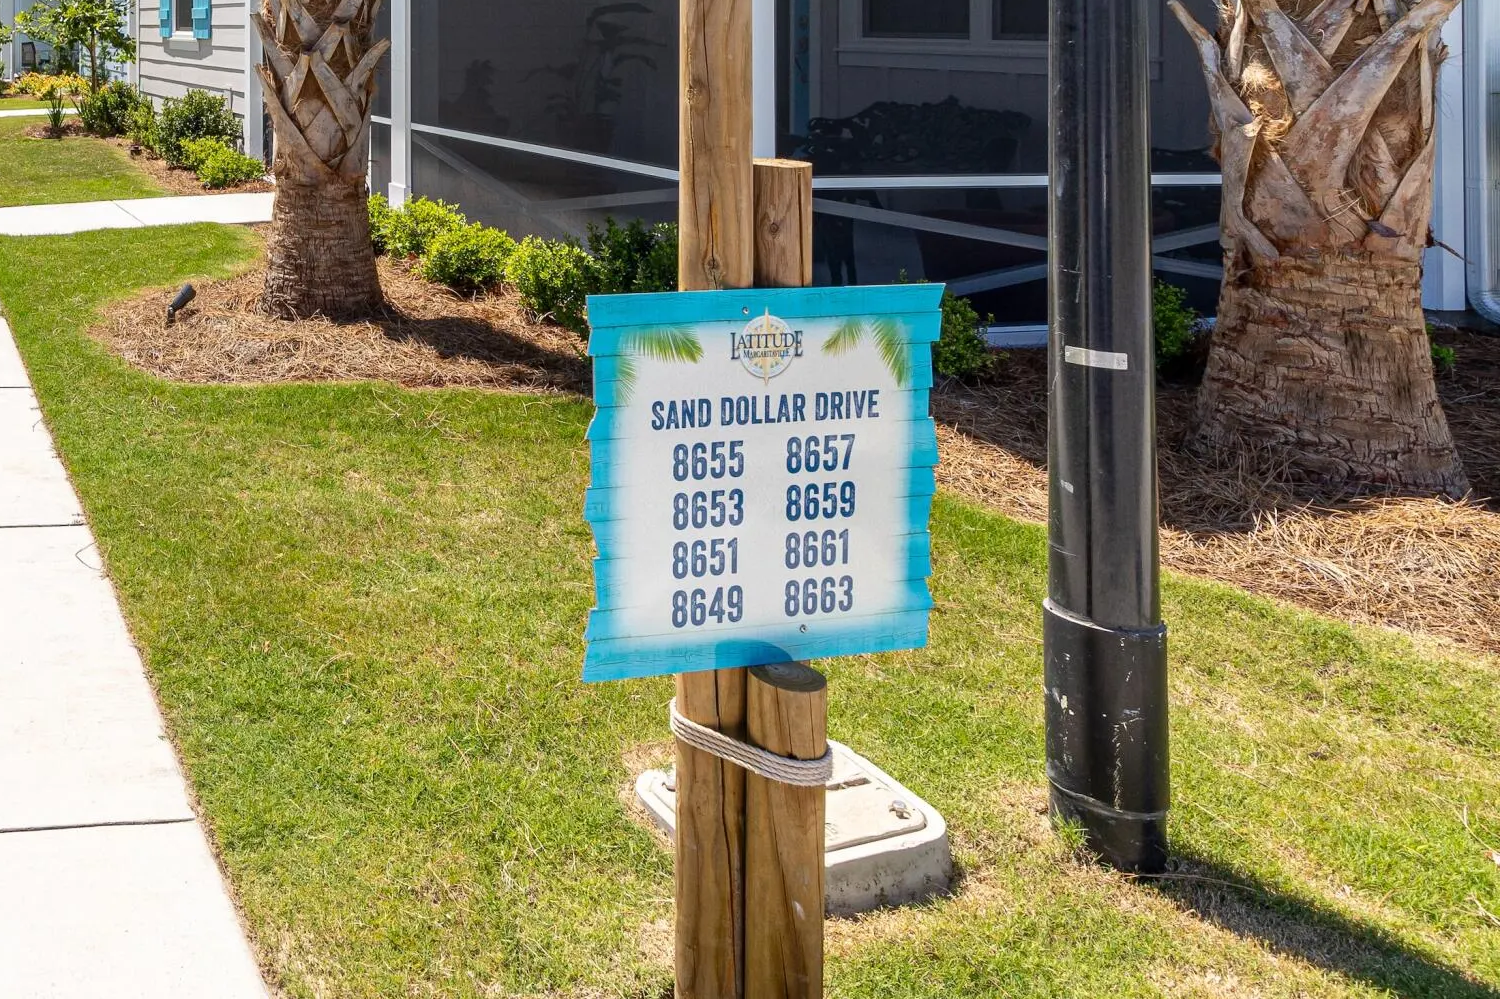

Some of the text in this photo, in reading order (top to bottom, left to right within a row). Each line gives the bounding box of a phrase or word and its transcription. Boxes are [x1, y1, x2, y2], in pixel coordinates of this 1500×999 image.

[730, 330, 804, 360] LATITUDE
[651, 389, 880, 431] SAND DOLLAR DRIVE
[673, 440, 745, 481] 8655
[786, 434, 856, 474] 8657
[673, 488, 744, 530] 8653
[786, 481, 856, 522] 8659
[672, 537, 739, 579] 8651
[785, 528, 849, 569] 8661
[672, 585, 743, 628] 8649
[784, 575, 853, 617] 8663
